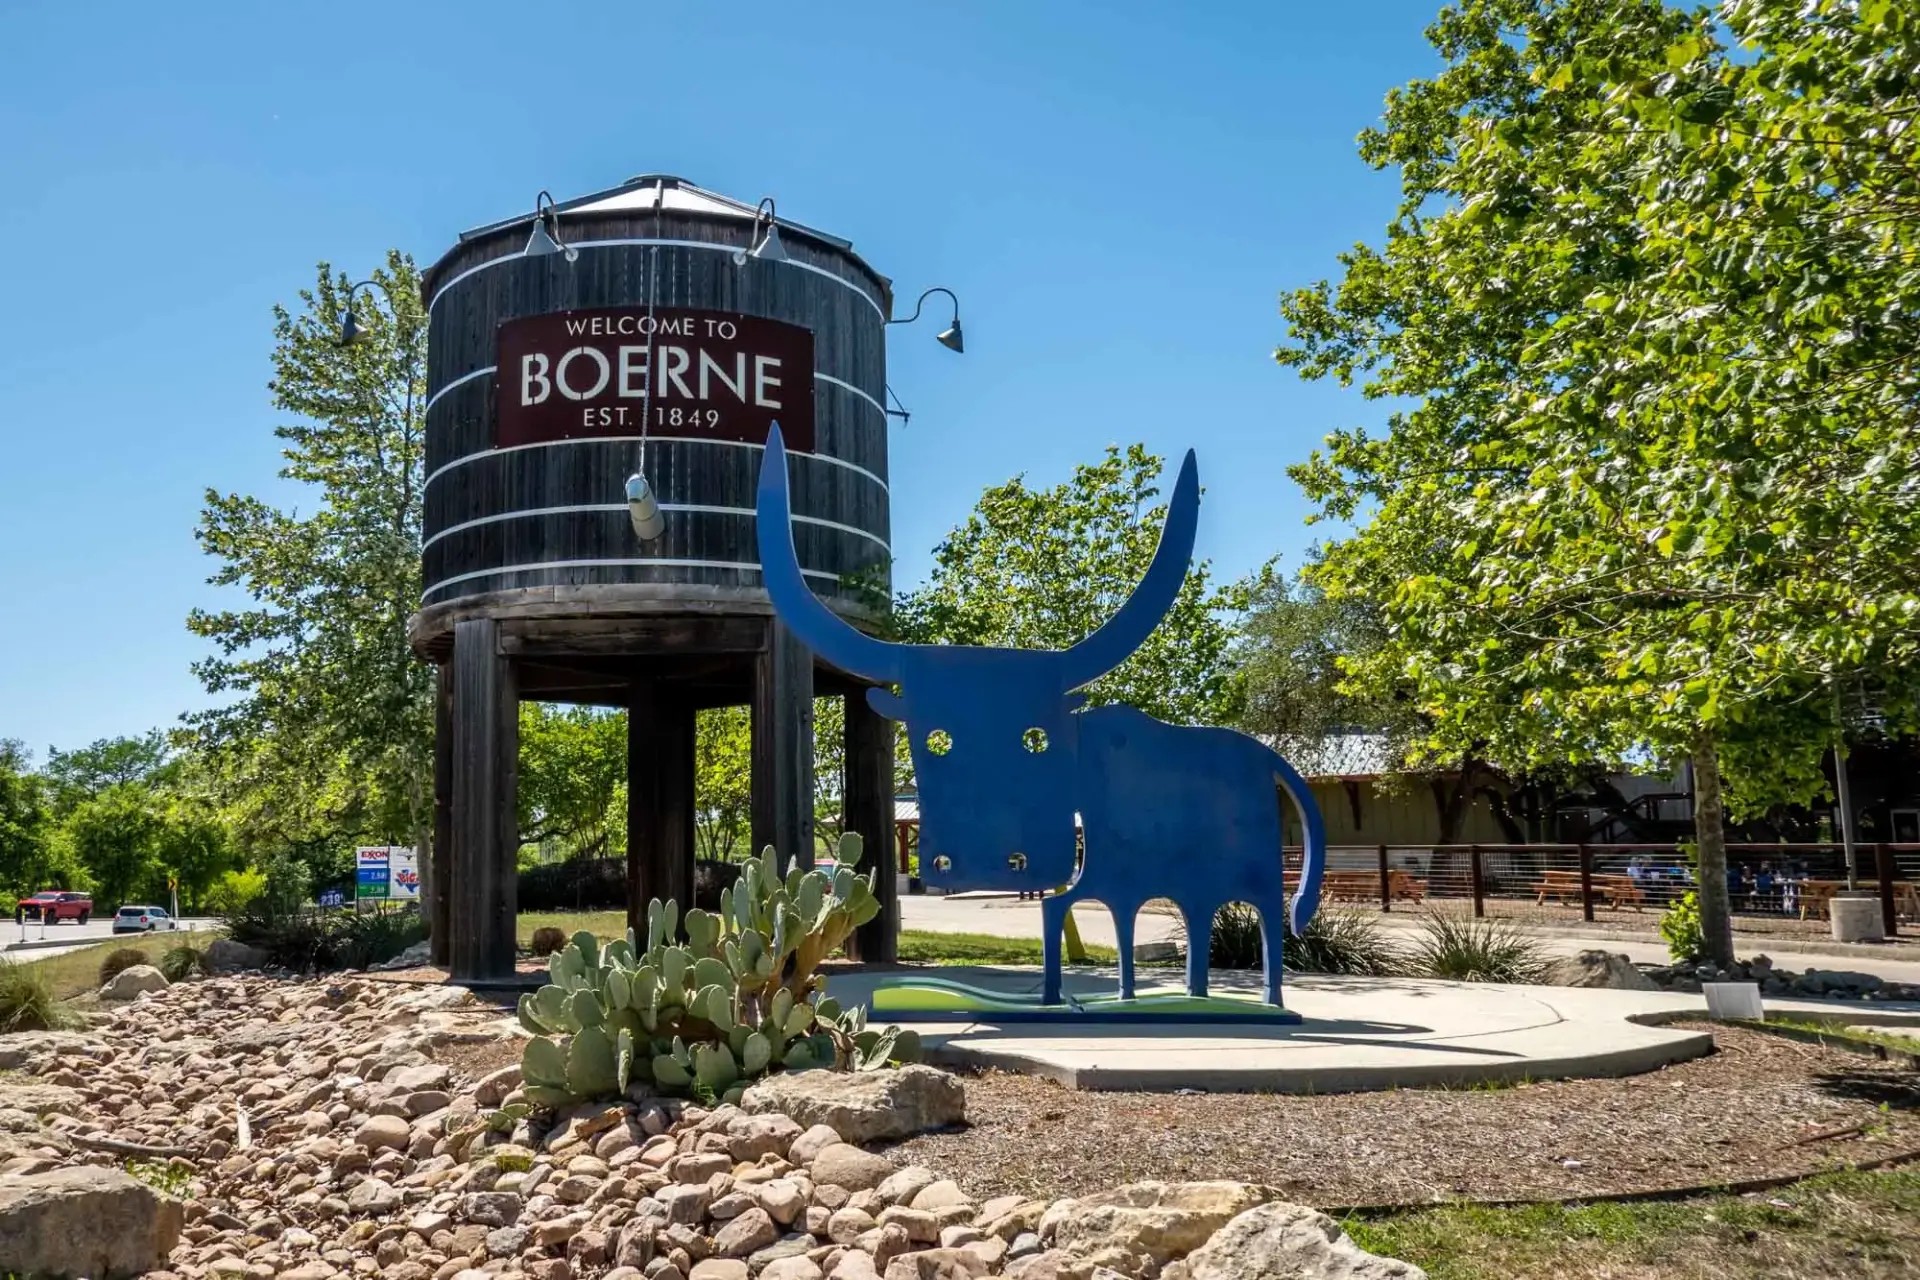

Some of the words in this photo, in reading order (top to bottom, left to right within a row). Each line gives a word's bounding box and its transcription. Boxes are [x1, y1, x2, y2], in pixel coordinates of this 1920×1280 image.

[565, 316, 696, 337] WELCOME
[704, 319, 737, 340] TO
[521, 345, 783, 410] BOERNE
[583, 407, 633, 427] EST.
[656, 407, 720, 428] 1849
[361, 851, 389, 859] EXXON
